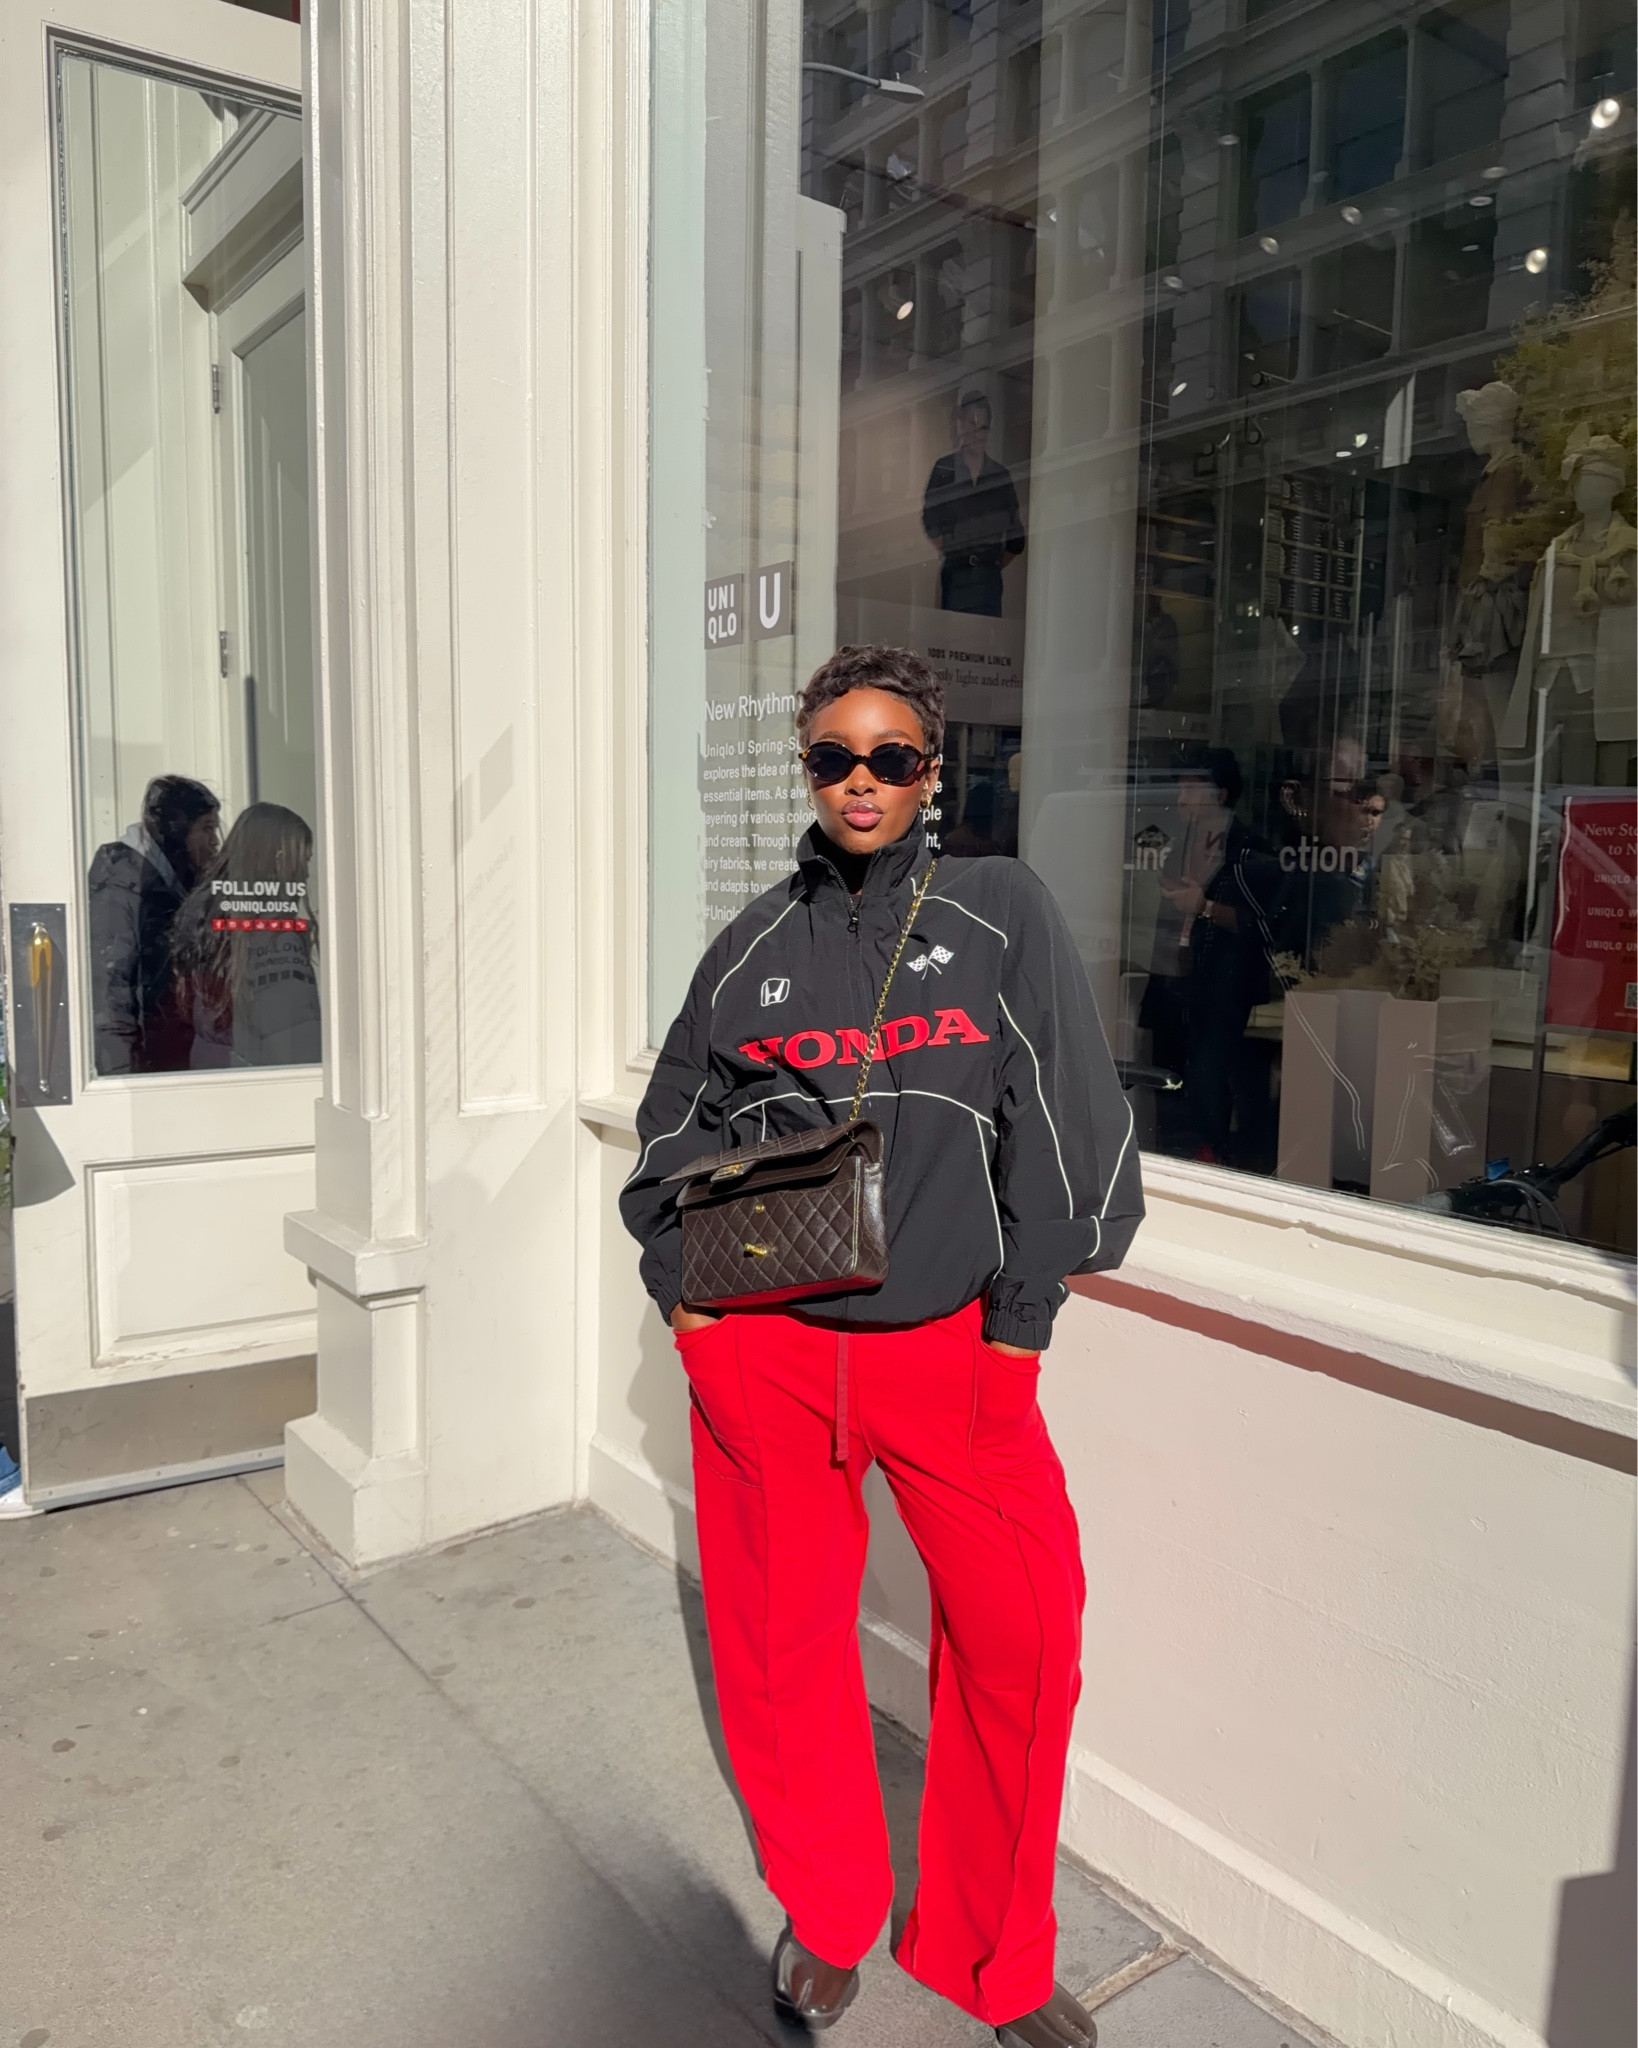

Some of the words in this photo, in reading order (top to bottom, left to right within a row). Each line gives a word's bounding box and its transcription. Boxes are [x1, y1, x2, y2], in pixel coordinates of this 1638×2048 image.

[708, 583, 735, 612] UNI
[759, 571, 781, 629] U
[708, 612, 737, 644] QLO
[949, 650, 985, 664] PREMIUM
[988, 655, 1012, 667] LINEN
[981, 673, 999, 687] and
[704, 700, 735, 721] New
[739, 692, 796, 722] Rhythm
[703, 743, 735, 759] Uniqlo
[737, 741, 745, 755] U
[748, 736, 802, 757] Spring-Su
[703, 766, 739, 783] explores
[741, 764, 756, 778] the
[757, 763, 777, 777] idea
[780, 761, 790, 776] of
[703, 787, 743, 803] essential
[745, 787, 773, 801] items.
[775, 786, 788, 800] As
[790, 785, 808, 800] alw
[703, 811, 738, 828] layering
[740, 810, 750, 824] of
[750, 810, 785, 824] various
[787, 809, 818, 824] colors
[1585, 823, 1616, 836] New
[703, 834, 719, 848] and
[720, 836, 750, 848] cream.
[752, 833, 790, 851] Through
[1608, 844, 1623, 856] to
[703, 856, 718, 873] airy
[719, 856, 752, 872] fabrics,
[753, 860, 767, 871] we
[703, 879, 719, 892] and
[720, 880, 749, 895] adapts
[750, 881, 760, 894] to
[1593, 873, 1631, 886] UNIQLO
[211, 880, 281, 896] FOLLOW
[286, 882, 307, 897] US
[220, 900, 299, 914] @UNIQLOUSA
[1587, 906, 1624, 919] UNIQLO
[1585, 939, 1623, 952] UNIQLO
